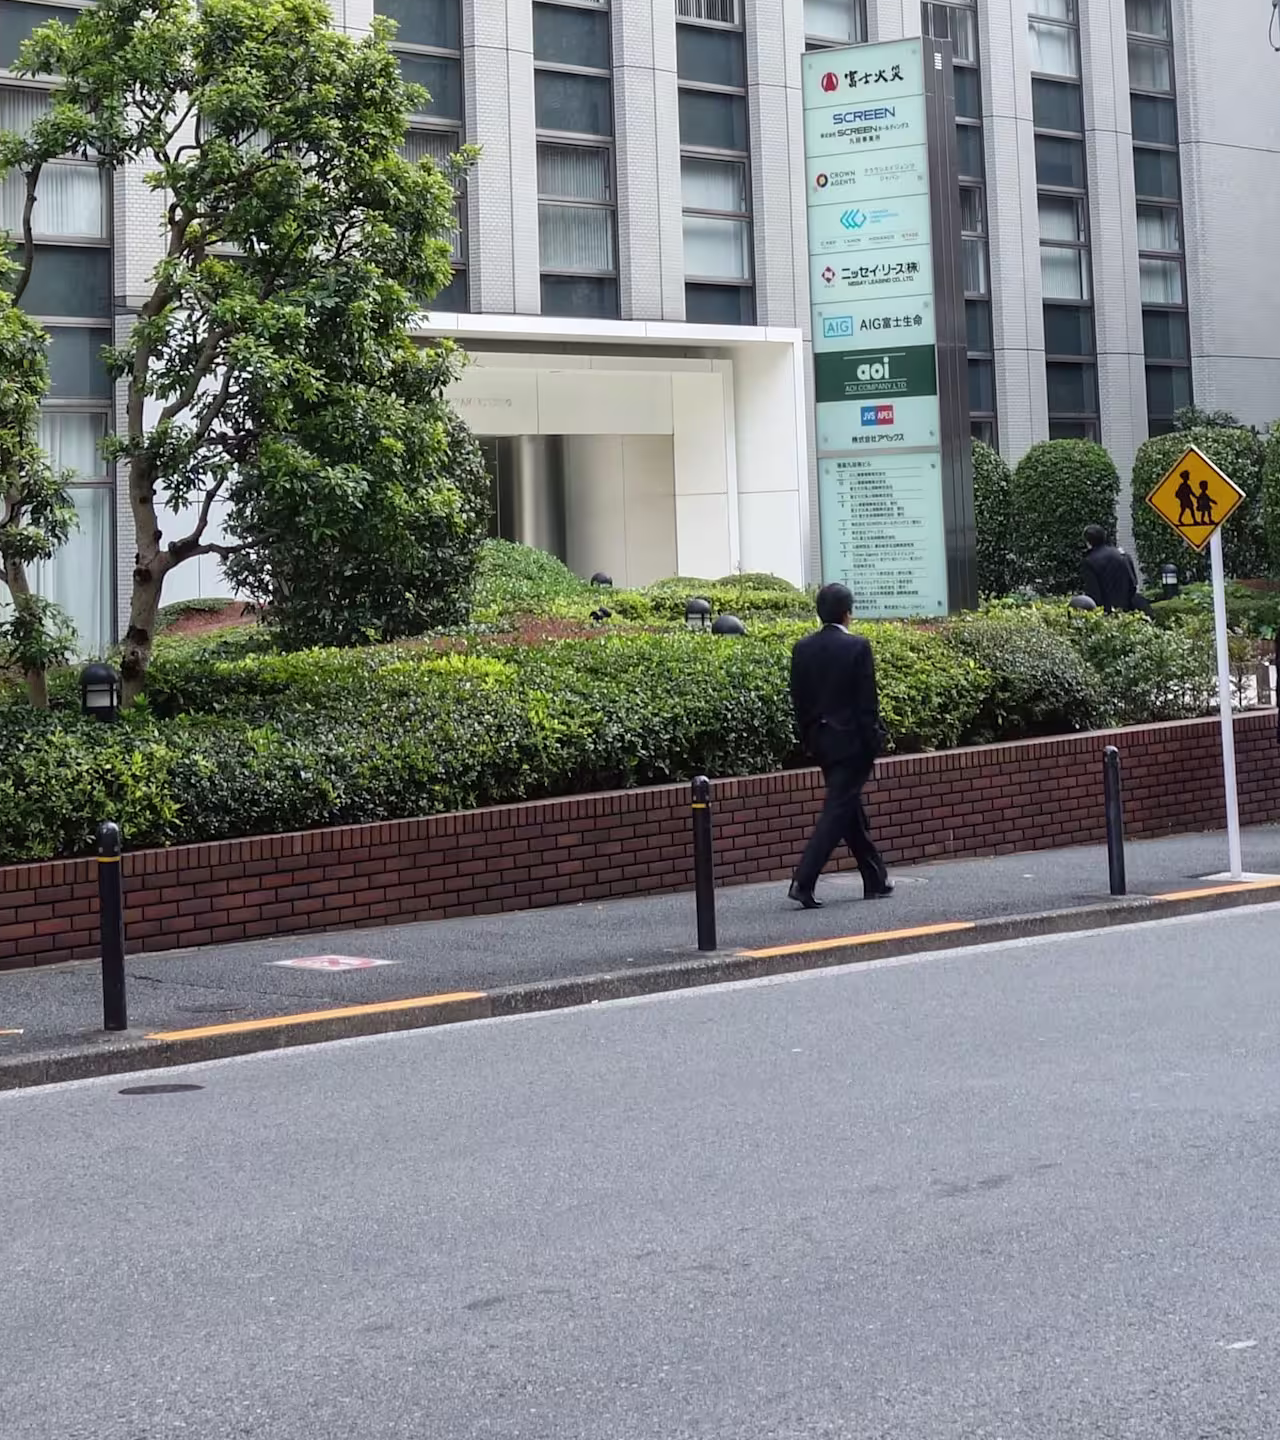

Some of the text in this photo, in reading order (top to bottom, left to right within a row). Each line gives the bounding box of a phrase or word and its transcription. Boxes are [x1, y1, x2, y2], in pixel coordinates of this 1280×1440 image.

[844, 64, 904, 88] 富士火災
[833, 106, 896, 125] SCREEN
[829, 170, 856, 178] CROWN
[830, 178, 856, 187] AGENTS
[826, 320, 849, 334] AIG
[860, 314, 923, 331] AIG富士生命
[856, 356, 890, 381] aoi
[863, 410, 893, 421] JVS APEX
